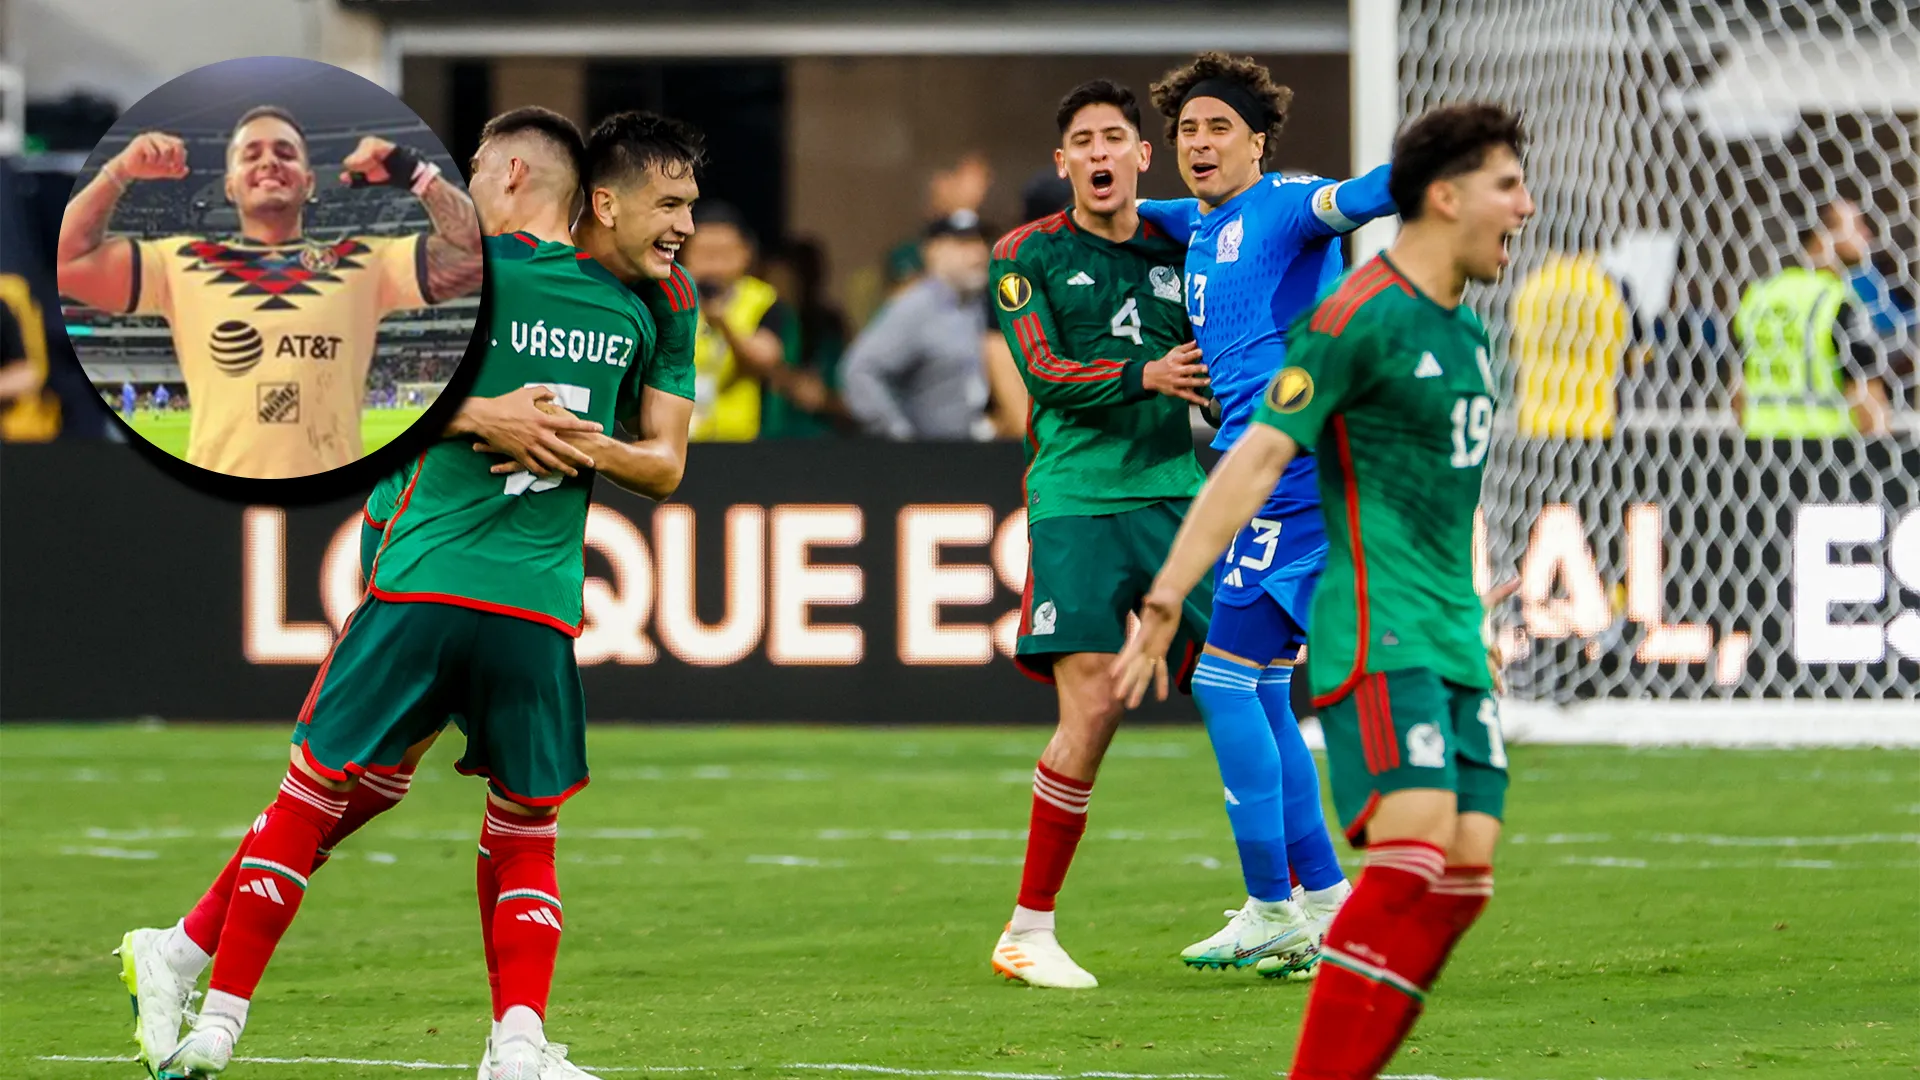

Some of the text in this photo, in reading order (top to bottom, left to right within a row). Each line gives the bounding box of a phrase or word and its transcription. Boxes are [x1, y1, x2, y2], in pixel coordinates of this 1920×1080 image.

[511, 320, 633, 368] VÁSQUEZ
[1111, 297, 1143, 345] 4
[275, 334, 342, 360] AT&T
[1450, 395, 1492, 468] 19
